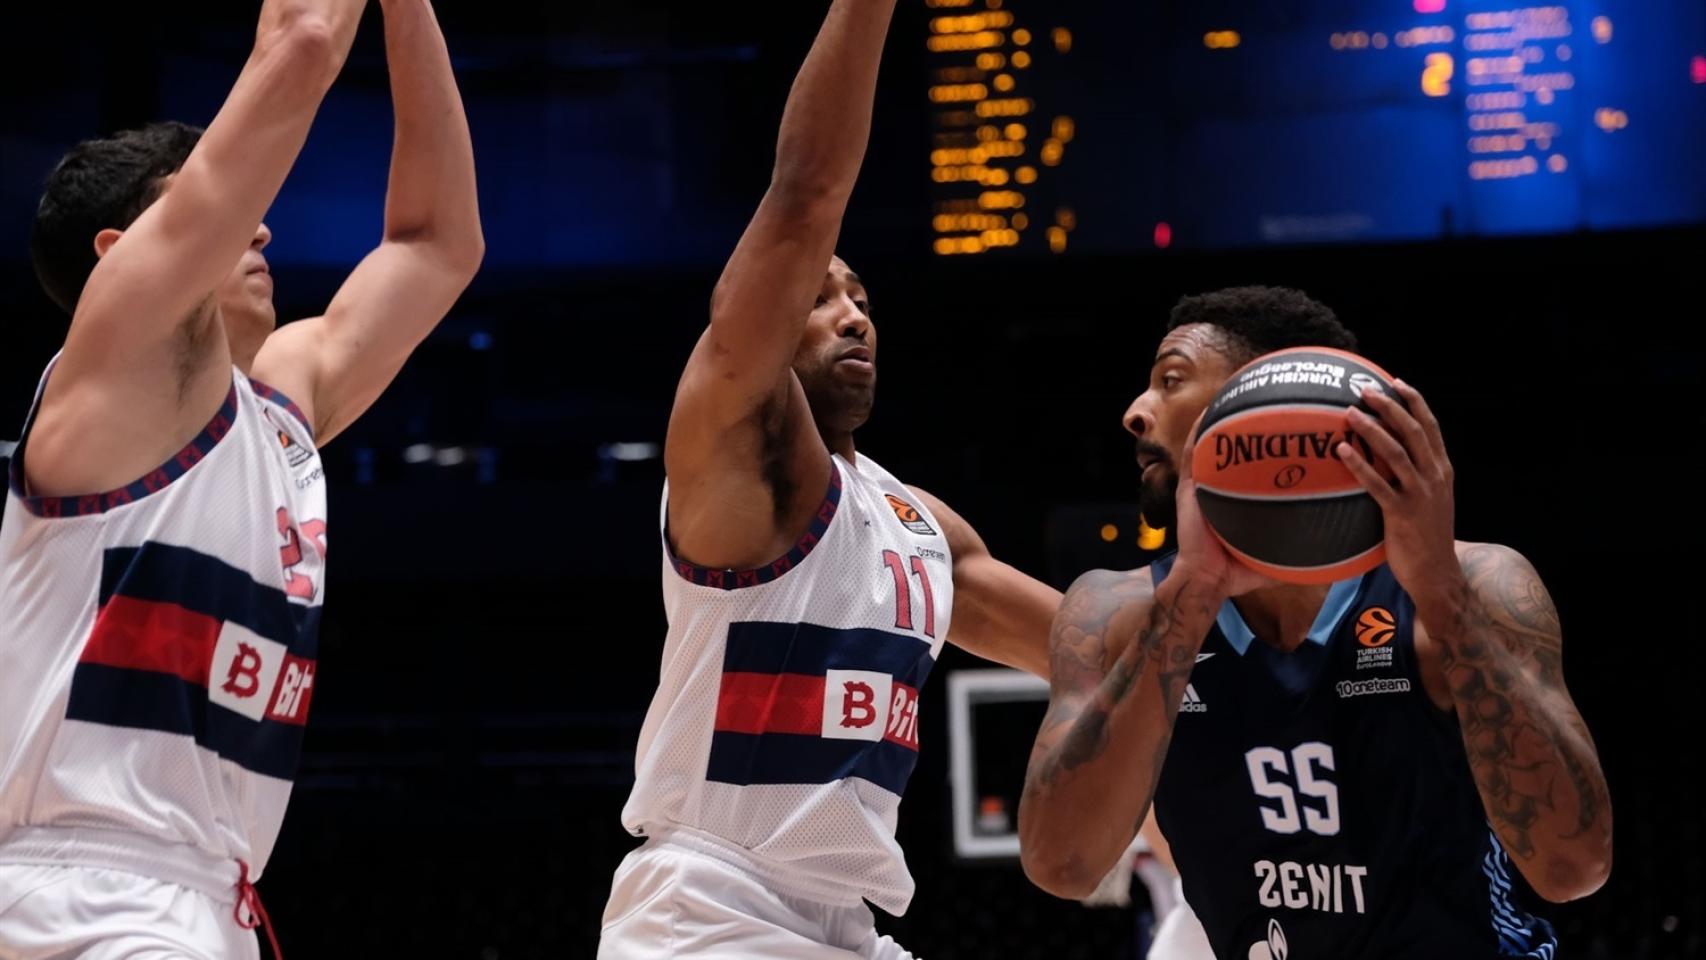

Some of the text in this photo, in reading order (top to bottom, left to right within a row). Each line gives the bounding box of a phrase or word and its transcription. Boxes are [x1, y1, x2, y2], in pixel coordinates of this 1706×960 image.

[1271, 372, 1342, 389] TURKISH
[882, 549, 936, 638] 11
[1357, 647, 1393, 656] TURKISH
[1357, 654, 1393, 663] AIRLINES
